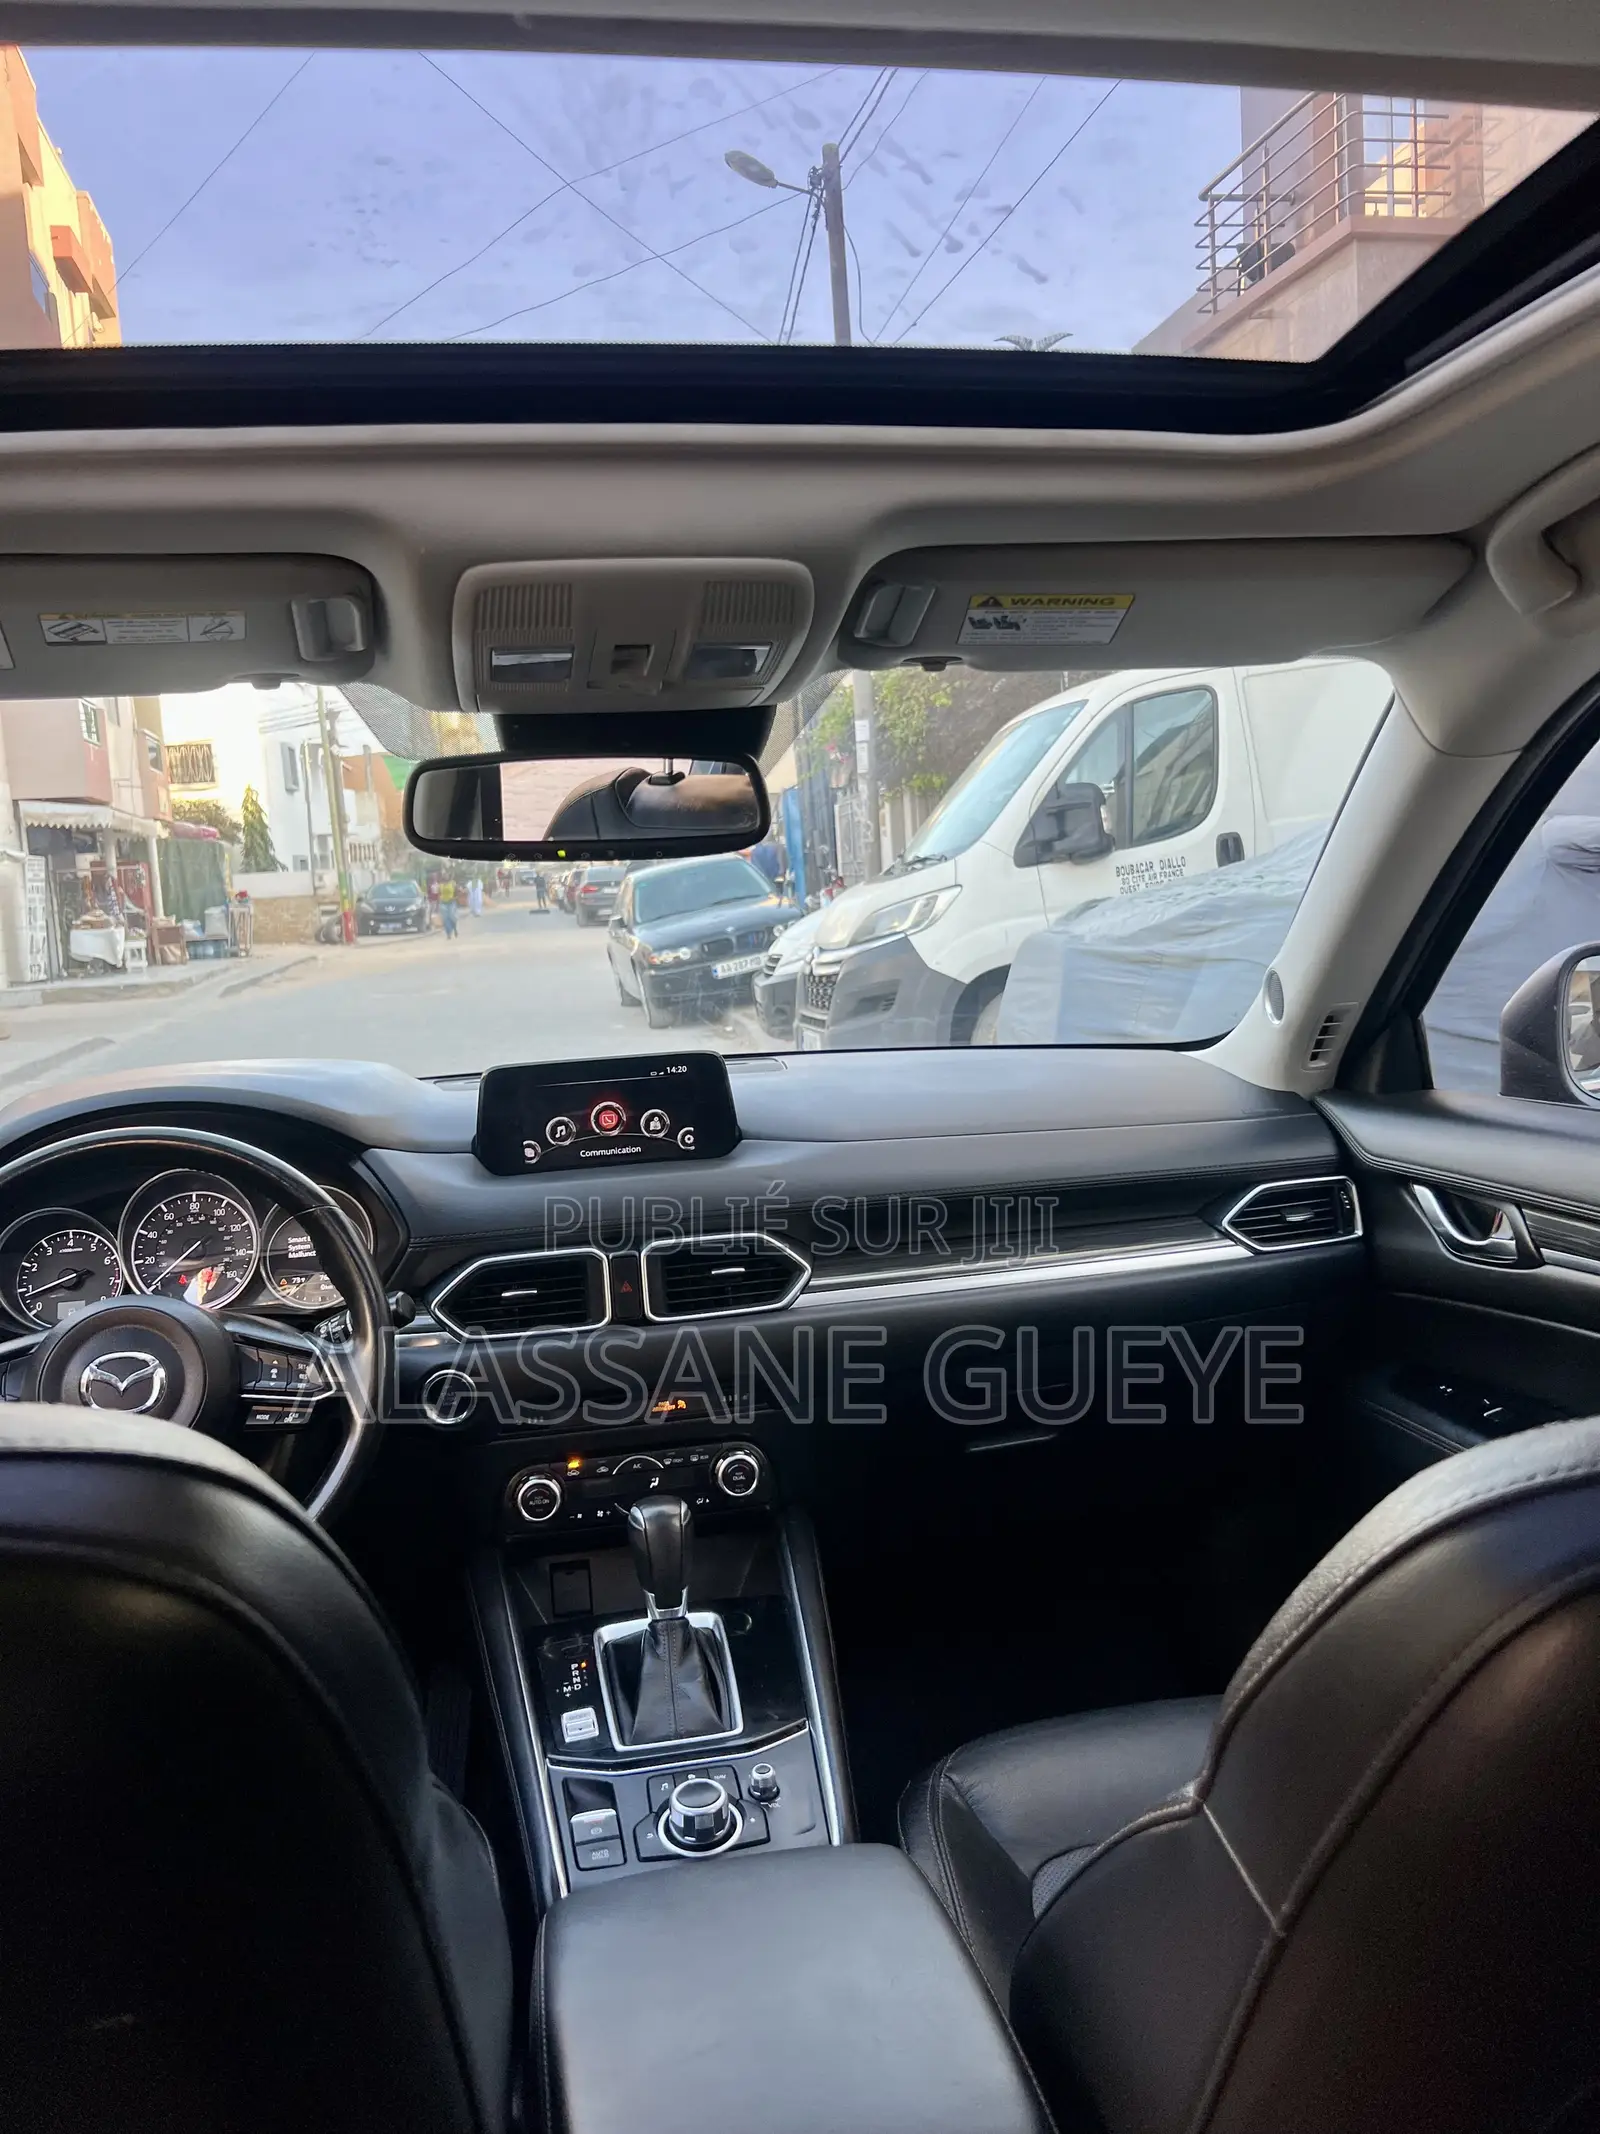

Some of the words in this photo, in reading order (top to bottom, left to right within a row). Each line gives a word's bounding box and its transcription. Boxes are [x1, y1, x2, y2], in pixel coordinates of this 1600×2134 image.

[1010, 597, 1116, 606] WARNING
[1116, 862, 1154, 877] BOUBACAR
[1160, 856, 1186, 870] DIALLO
[1132, 874, 1146, 884] CITE
[1148, 872, 1157, 881] AIR
[1160, 868, 1184, 879] FRANCE
[666, 1066, 687, 1074] 14:20
[580, 1145, 641, 1157] Communication
[214, 1208, 225, 1216] 100
[147, 1231, 157, 1239] 40
[288, 1236, 306, 1244] Smart
[46, 1247, 53, 1256] 3
[90, 1243, 96, 1252] 5
[104, 1256, 111, 1265] 6
[31, 1263, 38, 1271] 2
[109, 1277, 115, 1286] 7
[36, 1302, 42, 1310] 0
